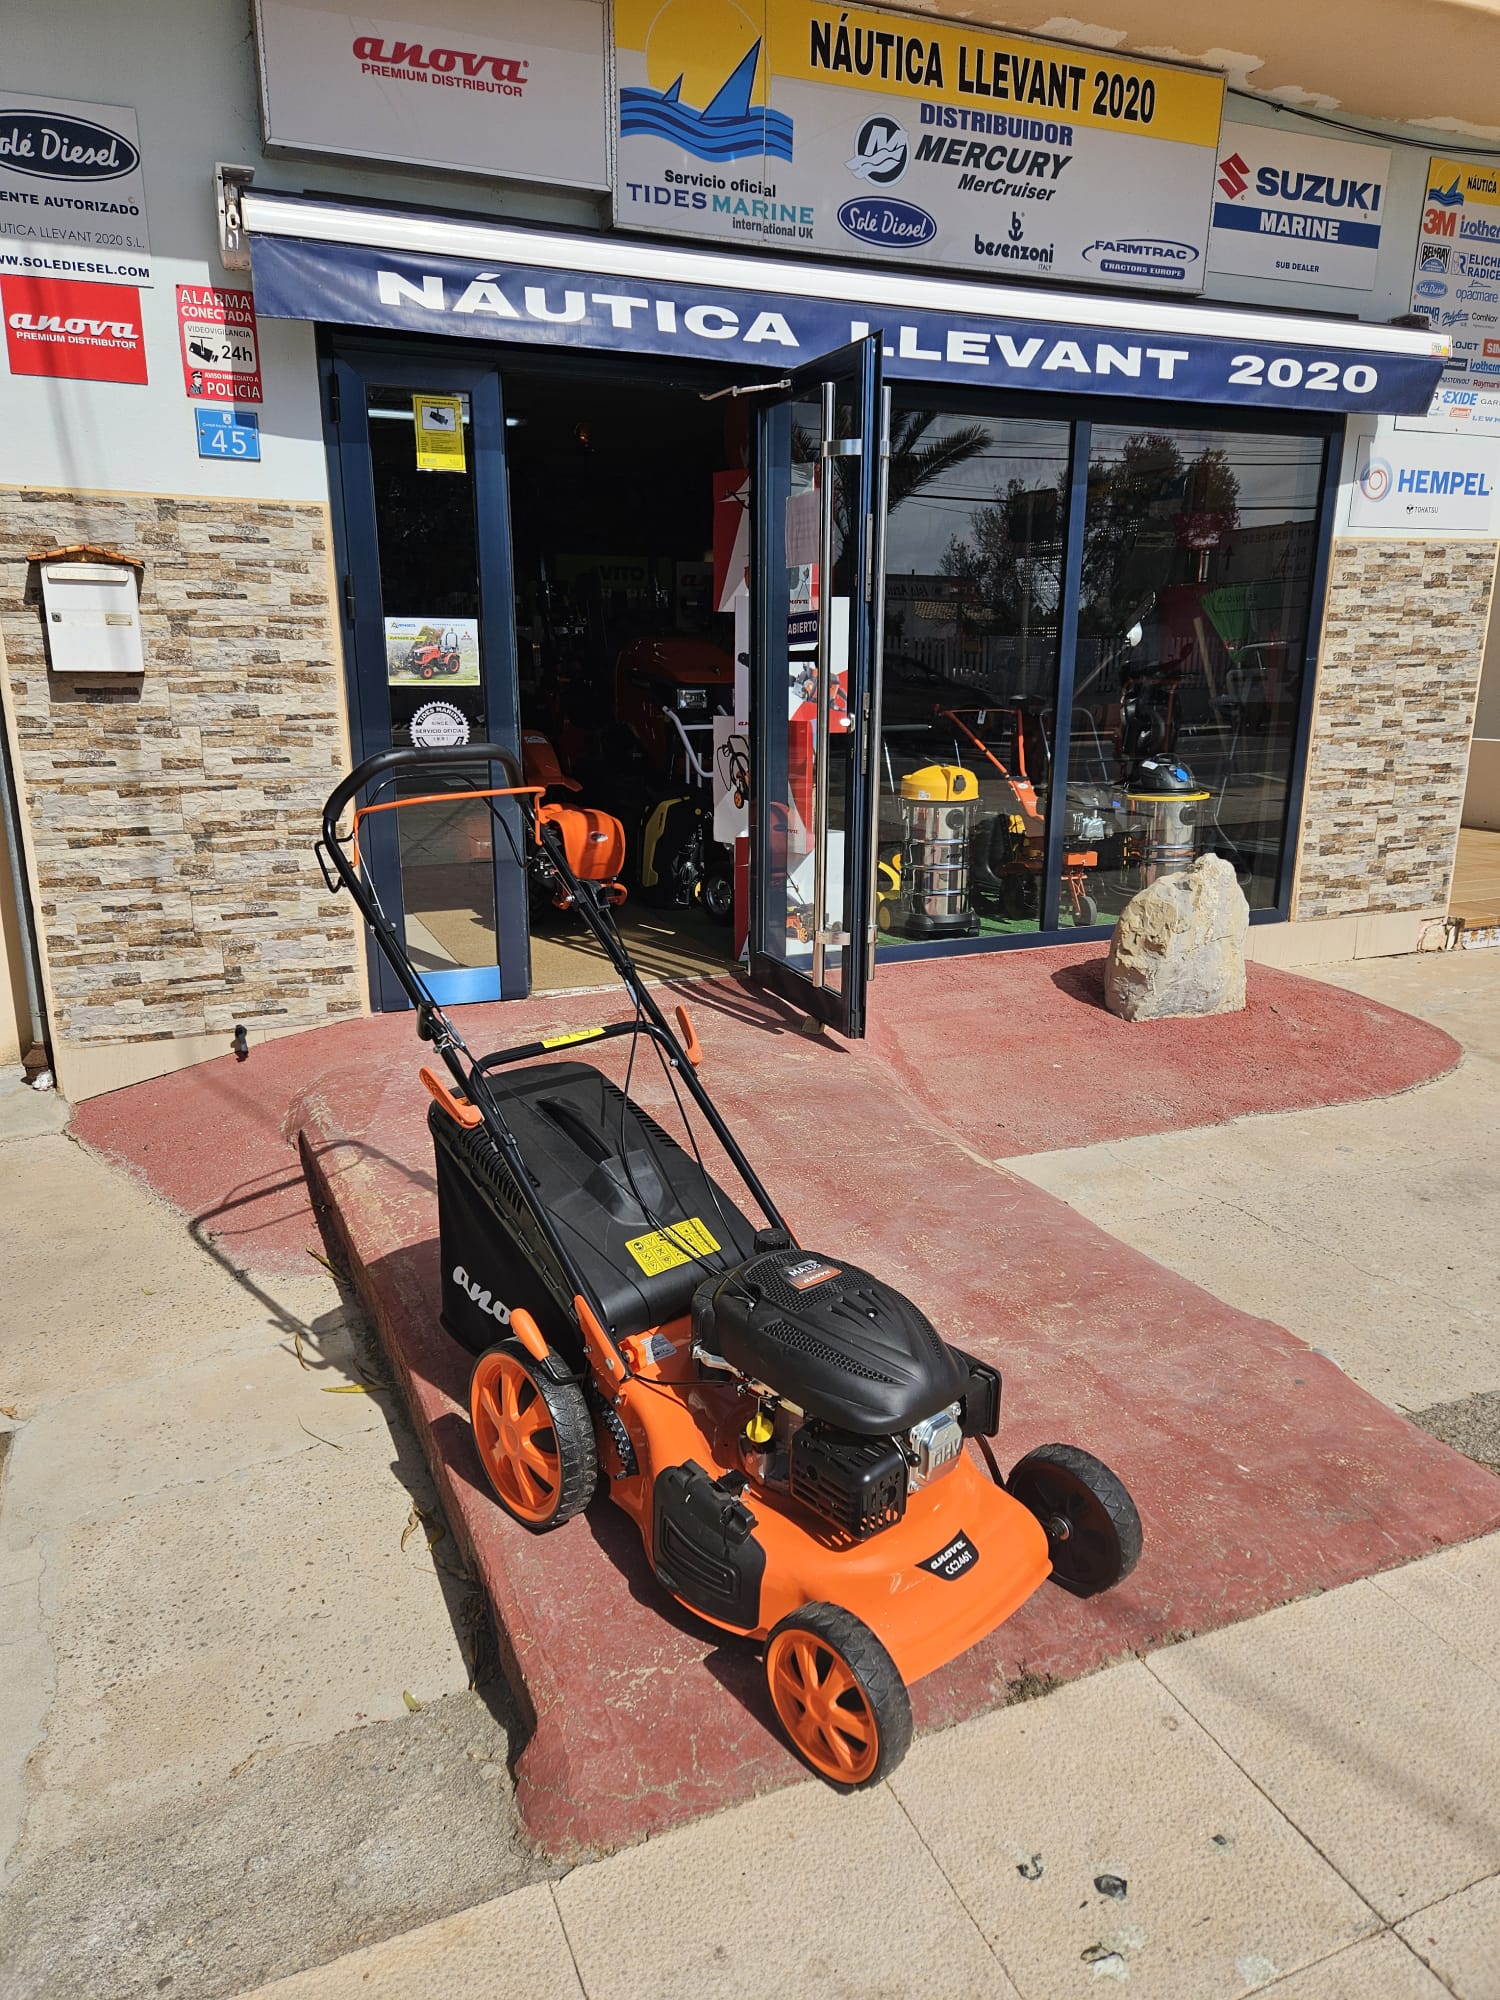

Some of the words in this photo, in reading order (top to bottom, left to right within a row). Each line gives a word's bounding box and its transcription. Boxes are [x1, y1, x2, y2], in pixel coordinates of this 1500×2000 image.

[361, 63, 427, 82] PREMIUM
[432, 74, 522, 97] DISTRIBUTOR
[811, 14, 943, 88] NÁUTICA
[958, 48, 1086, 112] LLEVANT
[1092, 71, 1155, 123] 2020
[920, 103, 1073, 146] DISTRIBUIDOR
[41, 128, 119, 168] Diesel
[914, 134, 1072, 180] MERCURY
[664, 170, 726, 189] Servicio
[731, 179, 776, 198] oficial
[958, 173, 1056, 202] MerCruiser
[1256, 166, 1382, 211] SUZUKI
[1467, 174, 1497, 194] NÁUTICA
[44, 196, 139, 216] AUTORIZADO
[626, 183, 707, 209] TIDES
[712, 194, 814, 225] MARINE
[733, 217, 796, 237] international
[798, 227, 813, 239] UK
[848, 206, 878, 231] Solé
[881, 210, 926, 238] Diesel
[1259, 211, 1340, 241] MARINE
[1423, 208, 1457, 237] 3M
[40, 227, 91, 243] LLEVANT
[95, 232, 123, 246] 2020
[126, 236, 145, 249] S.L.
[975, 234, 1054, 263] besenzoni
[1094, 240, 1187, 260] FARMTRAC
[1103, 261, 1148, 273] TRACTORS
[1150, 266, 1182, 277] EUROPE
[1276, 261, 1290, 270] SUB
[1292, 263, 1320, 273] DEALER
[181, 289, 251, 310] ALARMA
[9, 313, 139, 339] anova
[181, 306, 252, 323] CONECTADA
[16, 331, 65, 343] PREMIUM
[68, 337, 136, 349] DISTRIBUTOR
[187, 325, 251, 338] VIDEOVIGILANCIA
[376, 271, 800, 347] NÁUTICA
[1228, 355, 1379, 394] 2020
[221, 345, 253, 362] 24h
[207, 381, 261, 399] POLICÍA
[1442, 390, 1479, 406] EXIDE
[212, 430, 247, 455] 45
[1397, 469, 1489, 497] HEMPEL
[1414, 505, 1439, 514] TOHATSU
[787, 619, 818, 635] ABIERTO
[452, 1266, 511, 1325] ano
[930, 1539, 967, 1570] anova
[945, 1550, 973, 1575] CC246T
